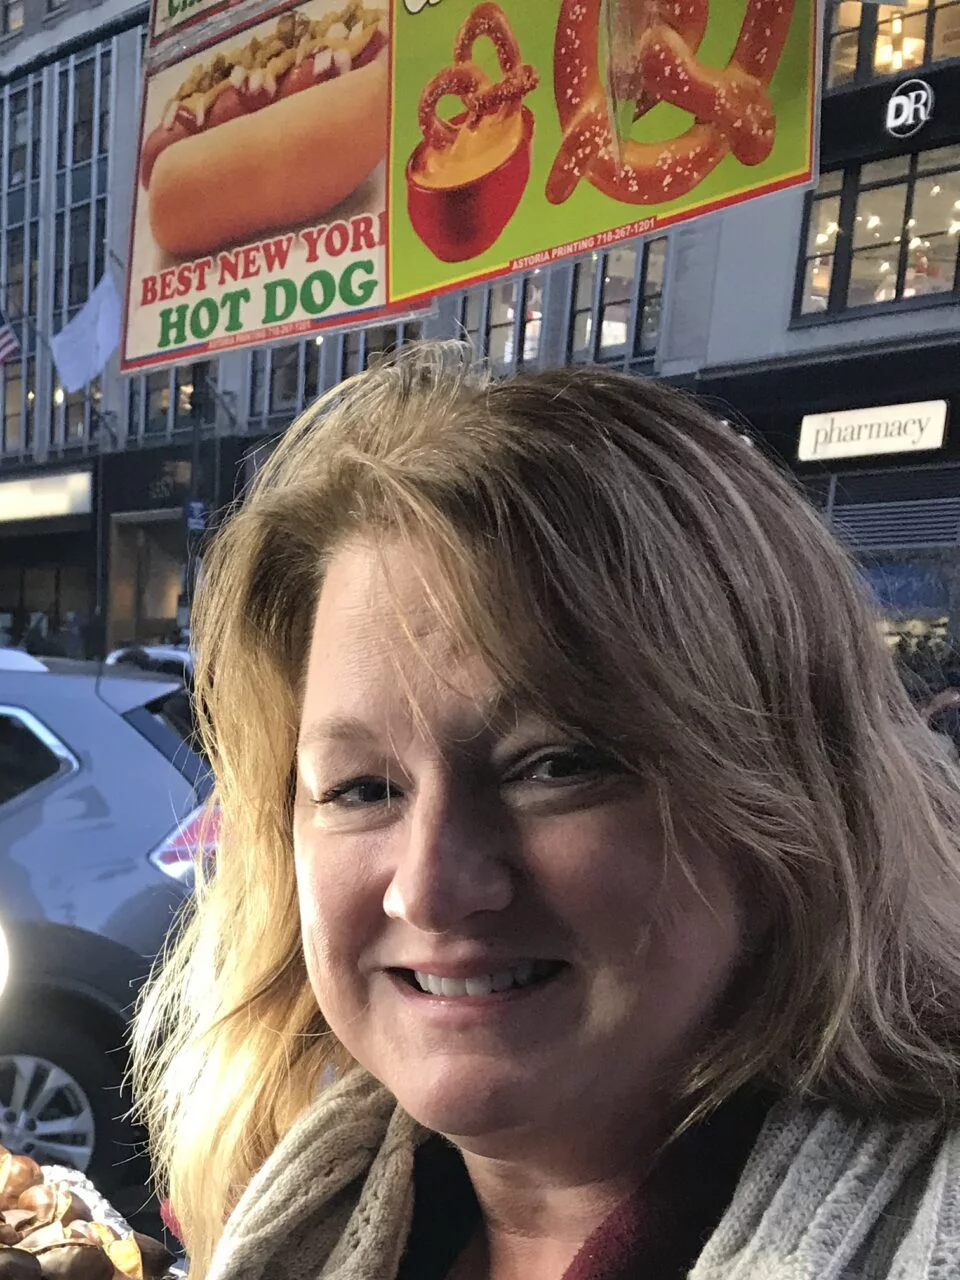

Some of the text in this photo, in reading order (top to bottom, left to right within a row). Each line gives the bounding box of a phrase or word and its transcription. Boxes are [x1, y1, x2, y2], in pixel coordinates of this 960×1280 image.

[886, 89, 931, 129] DR
[140, 257, 211, 306] BEST
[218, 235, 294, 286] NEW
[511, 217, 655, 271] ASTORIA PRINTING 718-267-1201
[158, 287, 250, 348] HOT
[262, 259, 378, 325] DOG
[812, 416, 932, 455] pharmacy
